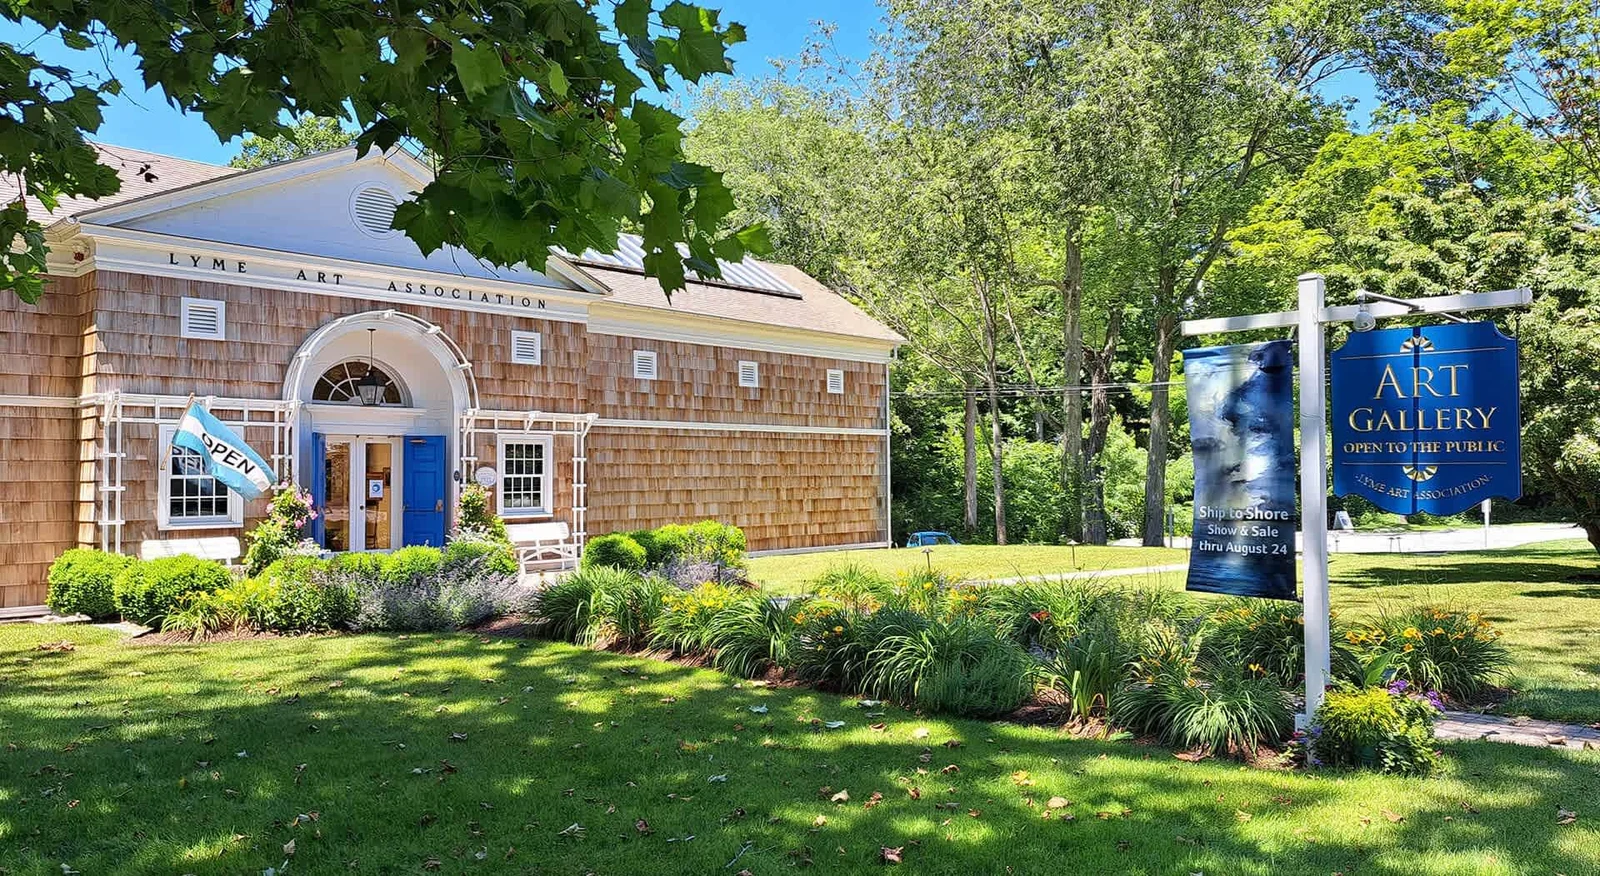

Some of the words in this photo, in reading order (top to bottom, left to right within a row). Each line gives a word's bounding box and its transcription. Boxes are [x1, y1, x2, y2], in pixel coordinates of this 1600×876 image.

[169, 253, 247, 273] LYME
[296, 269, 345, 285] ART
[387, 281, 548, 309] ASSOCIATION
[1373, 363, 1469, 400] ART
[1348, 406, 1497, 432] GALLERY
[201, 432, 256, 475] OPEN
[1343, 442, 1384, 454] OPEN
[1386, 441, 1407, 453] TO
[1410, 441, 1441, 453] THE
[1446, 440, 1505, 453] PUBLIC
[1386, 487, 1410, 499] ART
[1199, 506, 1225, 521] Ship
[1229, 508, 1243, 520] to
[1245, 506, 1289, 520] Shore
[1207, 524, 1238, 536] Show
[1240, 525, 1249, 536] &
[1251, 525, 1279, 538] Sale
[1199, 541, 1223, 552] thru
[1225, 541, 1268, 556] August
[1271, 543, 1288, 555] 24
